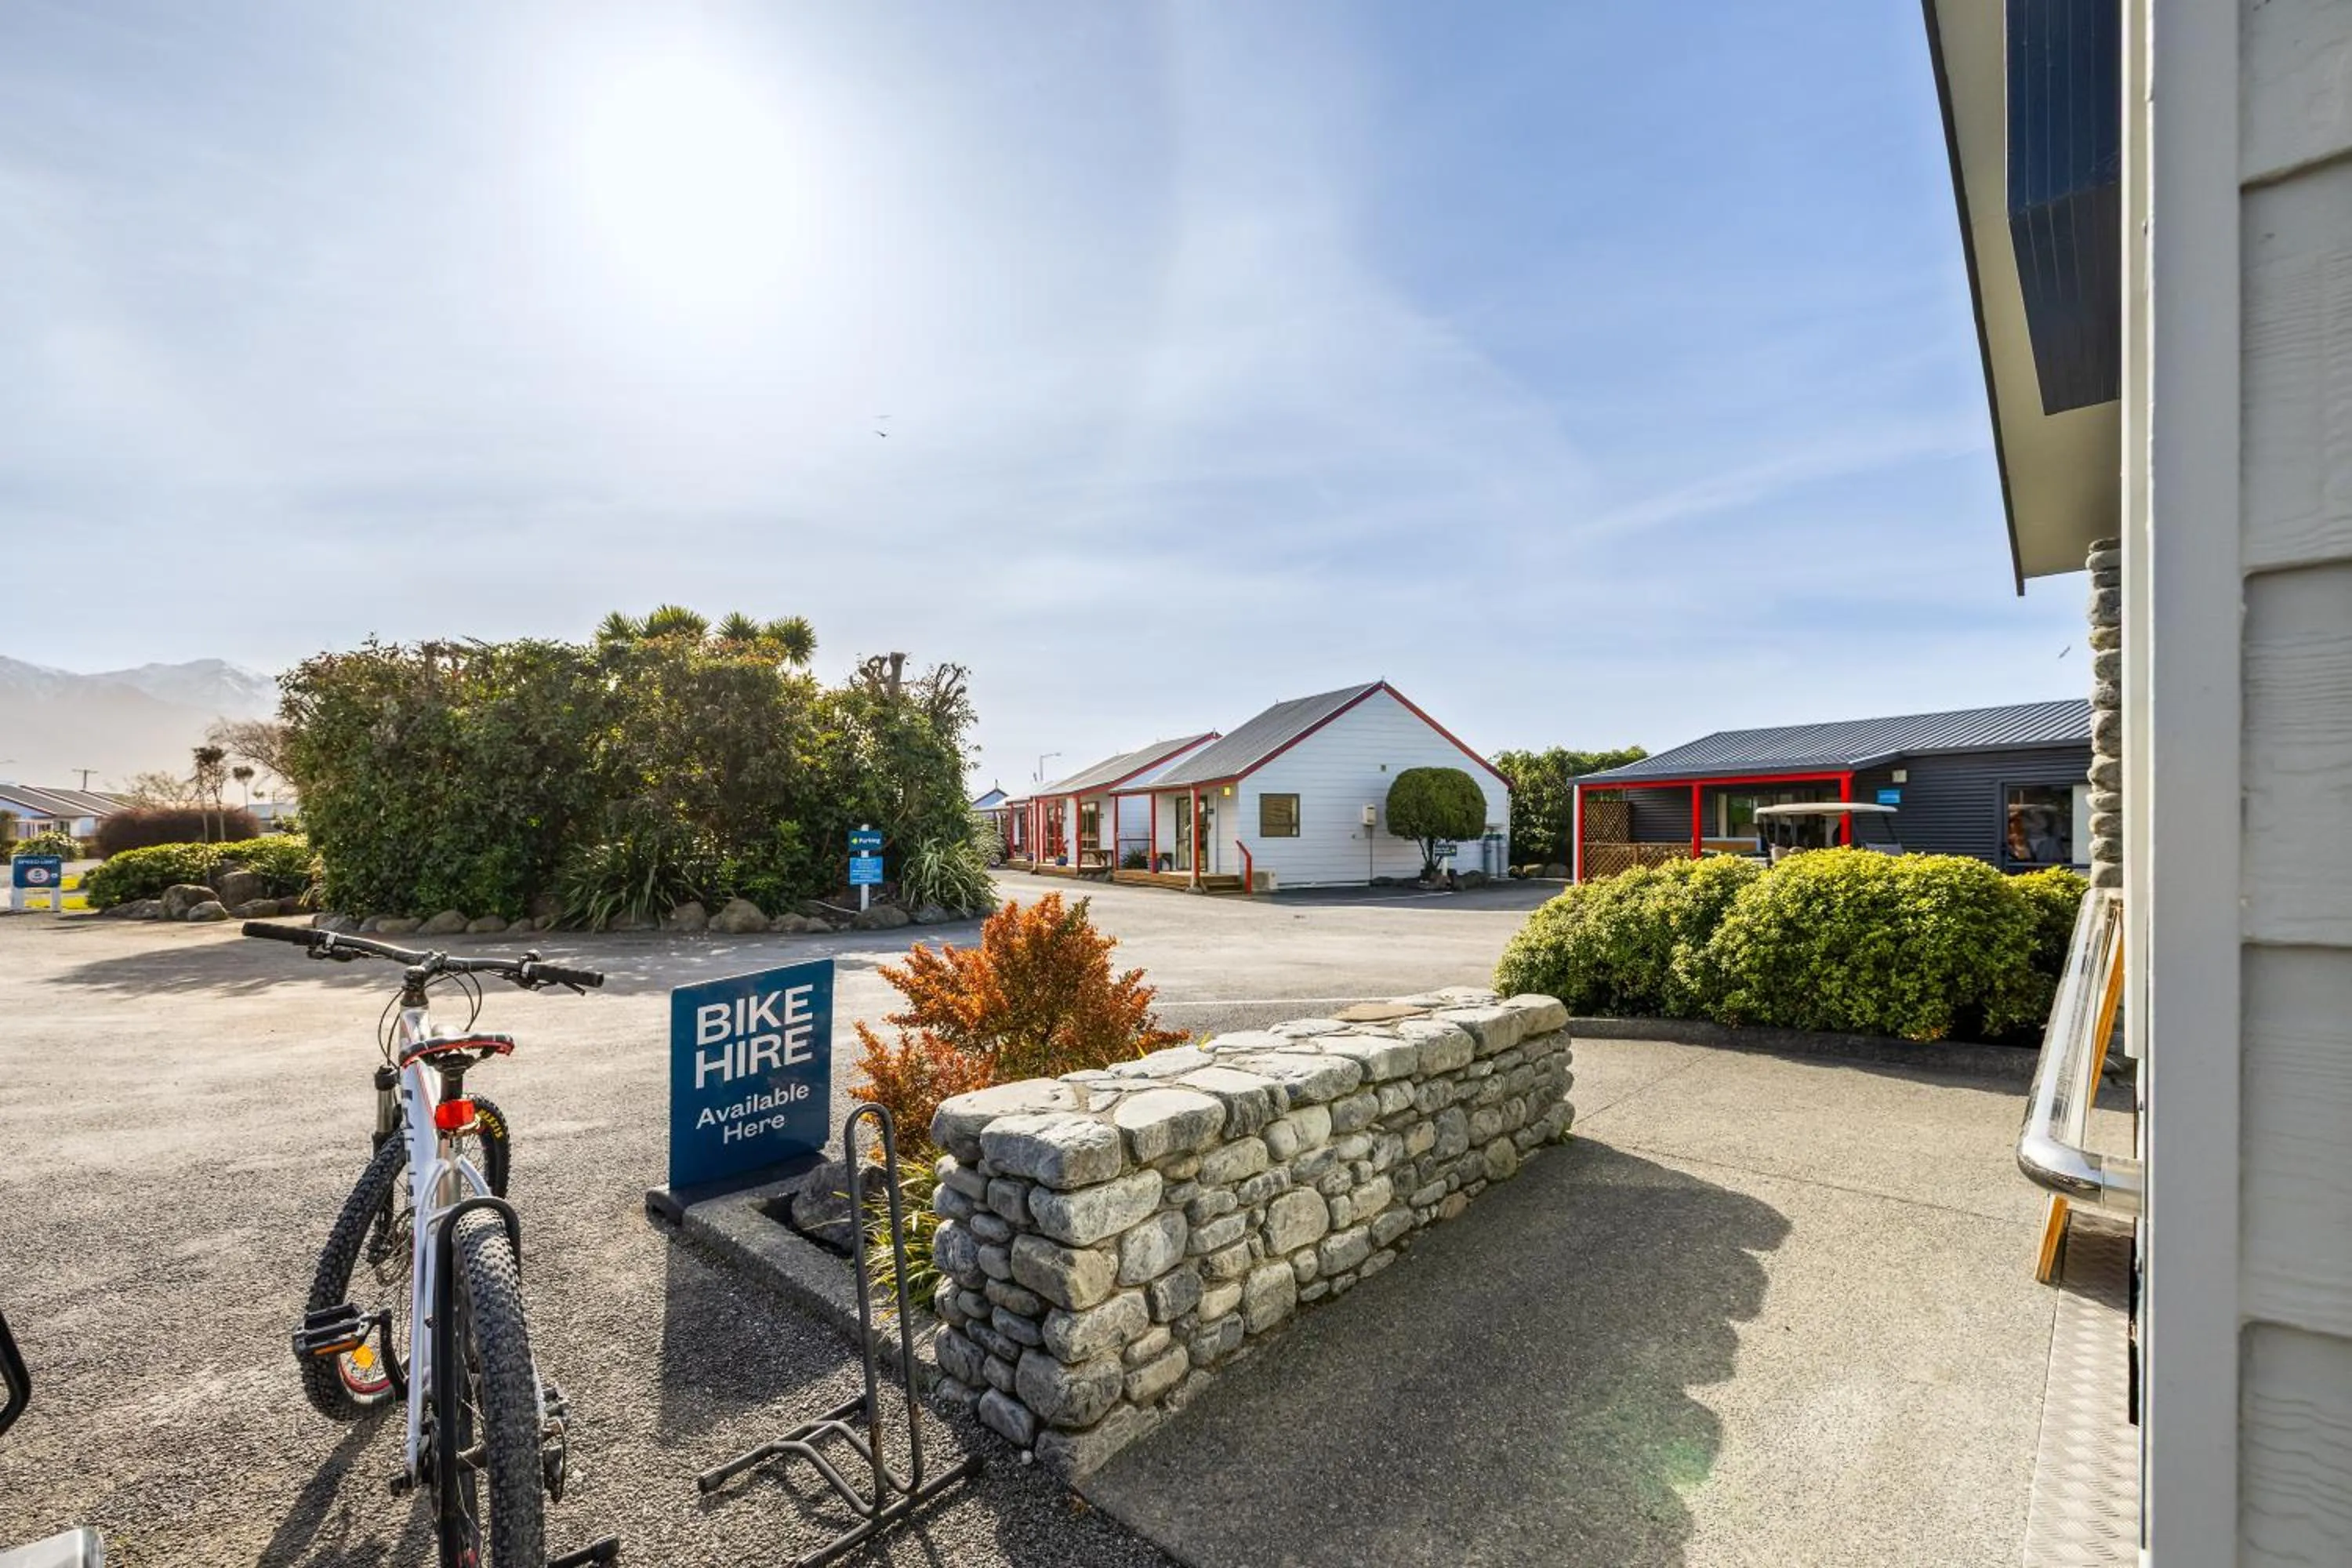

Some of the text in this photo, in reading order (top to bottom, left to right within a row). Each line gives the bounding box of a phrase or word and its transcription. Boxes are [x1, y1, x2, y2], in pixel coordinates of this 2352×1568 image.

[697, 984, 813, 1046] BIKE
[695, 1025, 813, 1089] HIRE
[696, 1083, 810, 1129] Available
[724, 1114, 785, 1144] Here
